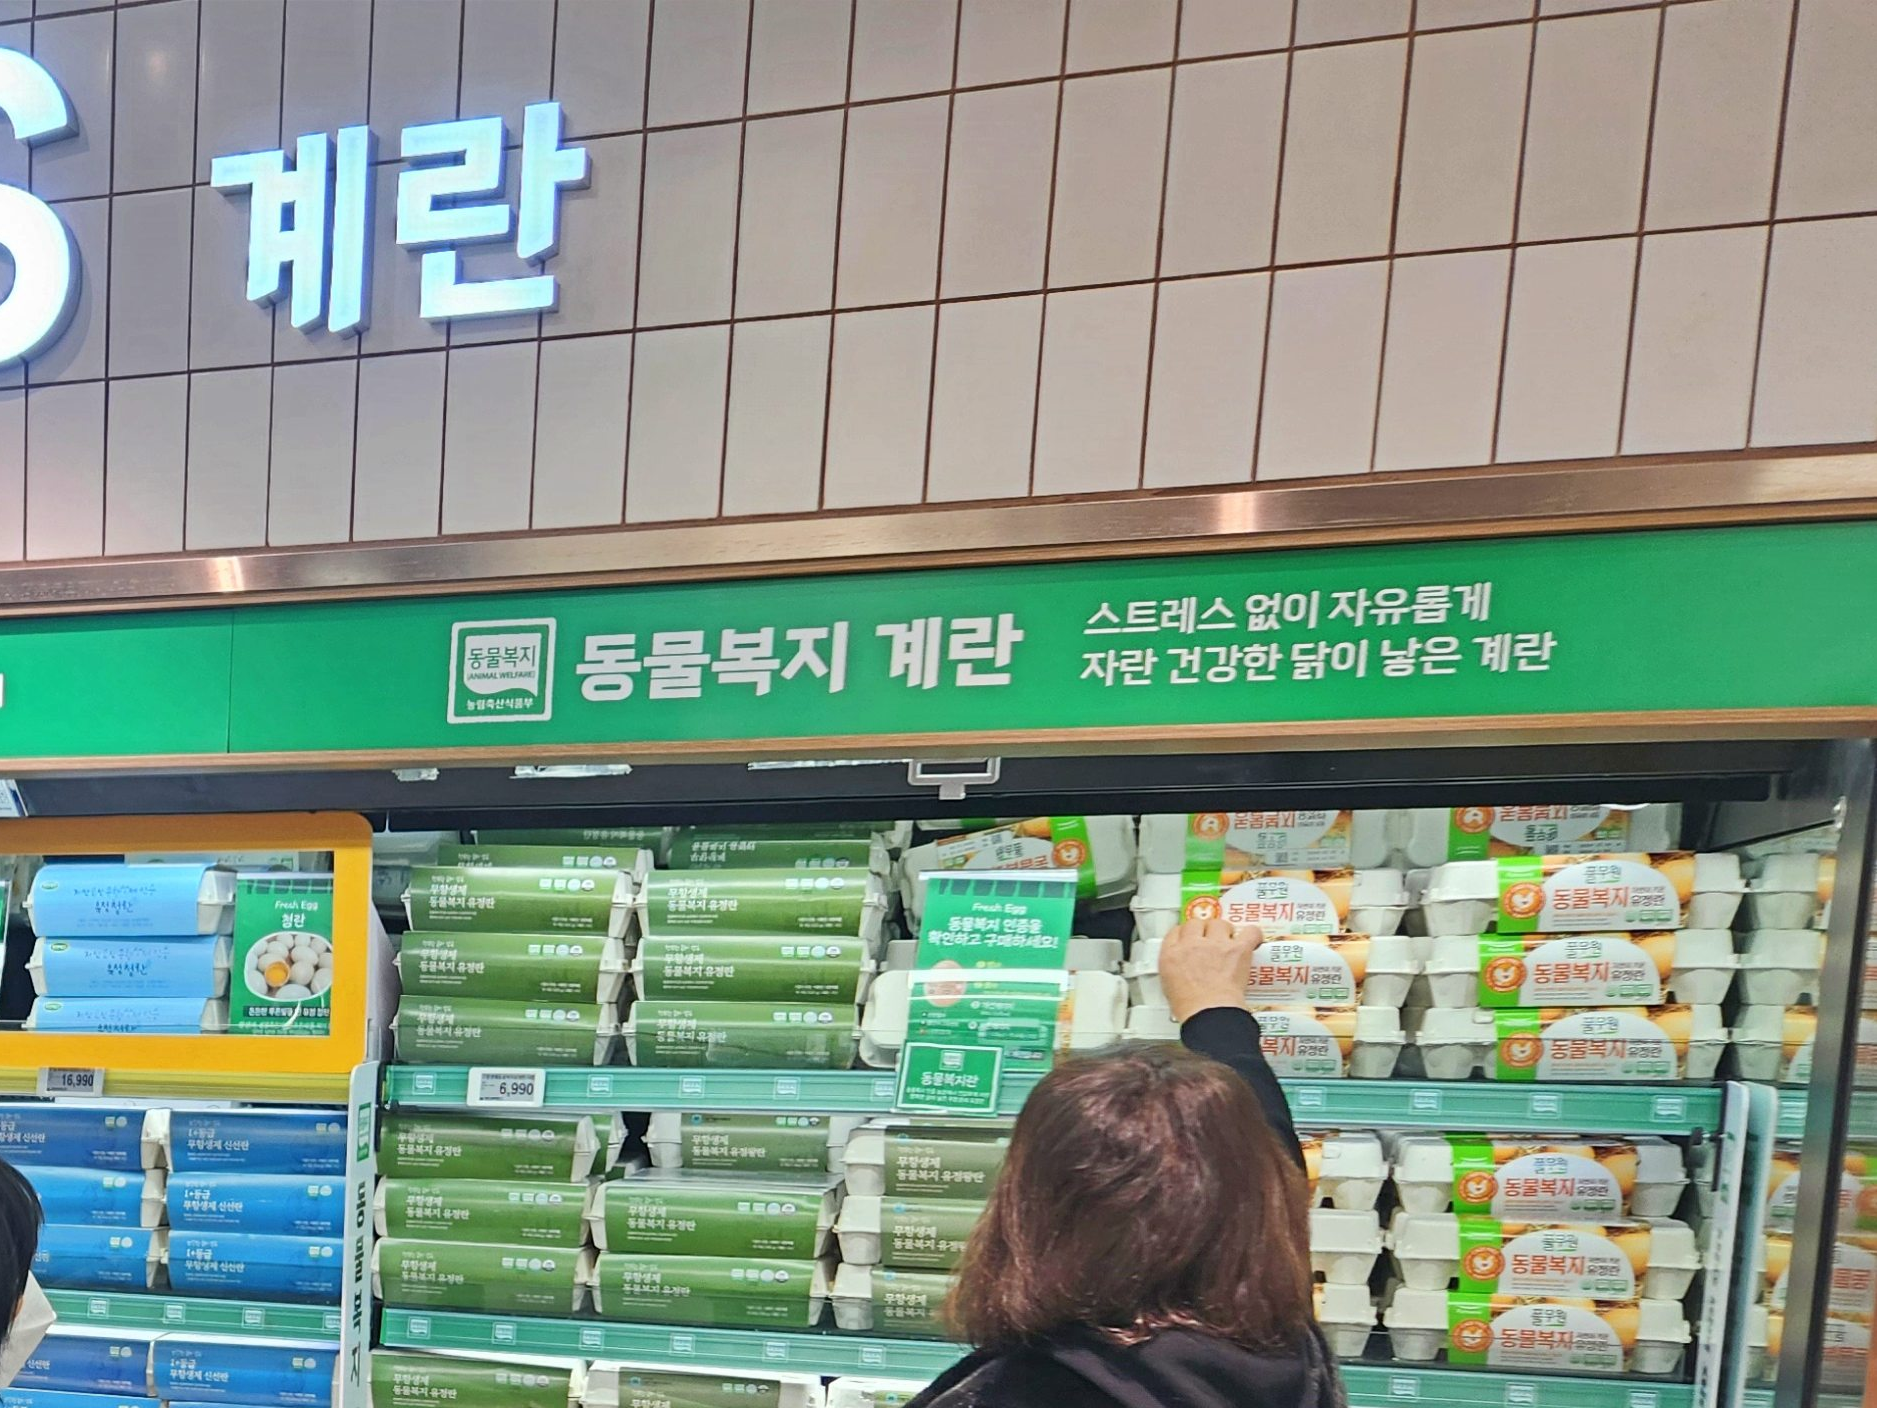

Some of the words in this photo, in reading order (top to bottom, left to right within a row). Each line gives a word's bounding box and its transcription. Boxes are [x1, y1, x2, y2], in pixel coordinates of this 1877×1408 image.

[211, 101, 591, 333] 계란
[1085, 595, 1234, 636] 스트레스
[1244, 591, 1318, 632] 없이
[1327, 582, 1492, 625] 자유롭게
[467, 645, 536, 669] 동물복지
[575, 621, 849, 702] 동물복지
[876, 612, 1025, 690] 계란
[1083, 649, 1156, 688] 자란
[1166, 641, 1282, 684] 건강한
[1292, 639, 1368, 680] 닭이
[1380, 635, 1462, 675] 낳은
[1473, 630, 1558, 672] 계란
[275, 901, 299, 910] Fresh
[301, 901, 318, 911] Egg
[1005, 904, 1027, 914] Egg
[1553, 887, 1629, 910] 동물복지
[282, 913, 306, 928] 청란
[1228, 902, 1294, 922] 동물복지
[949, 917, 999, 931] 동물복지
[1534, 962, 1610, 984] 동물복지
[62, 1073, 94, 1088] 16,990
[499, 1082, 534, 1098] 6,990
[1503, 1176, 1575, 1200] 동물복지
